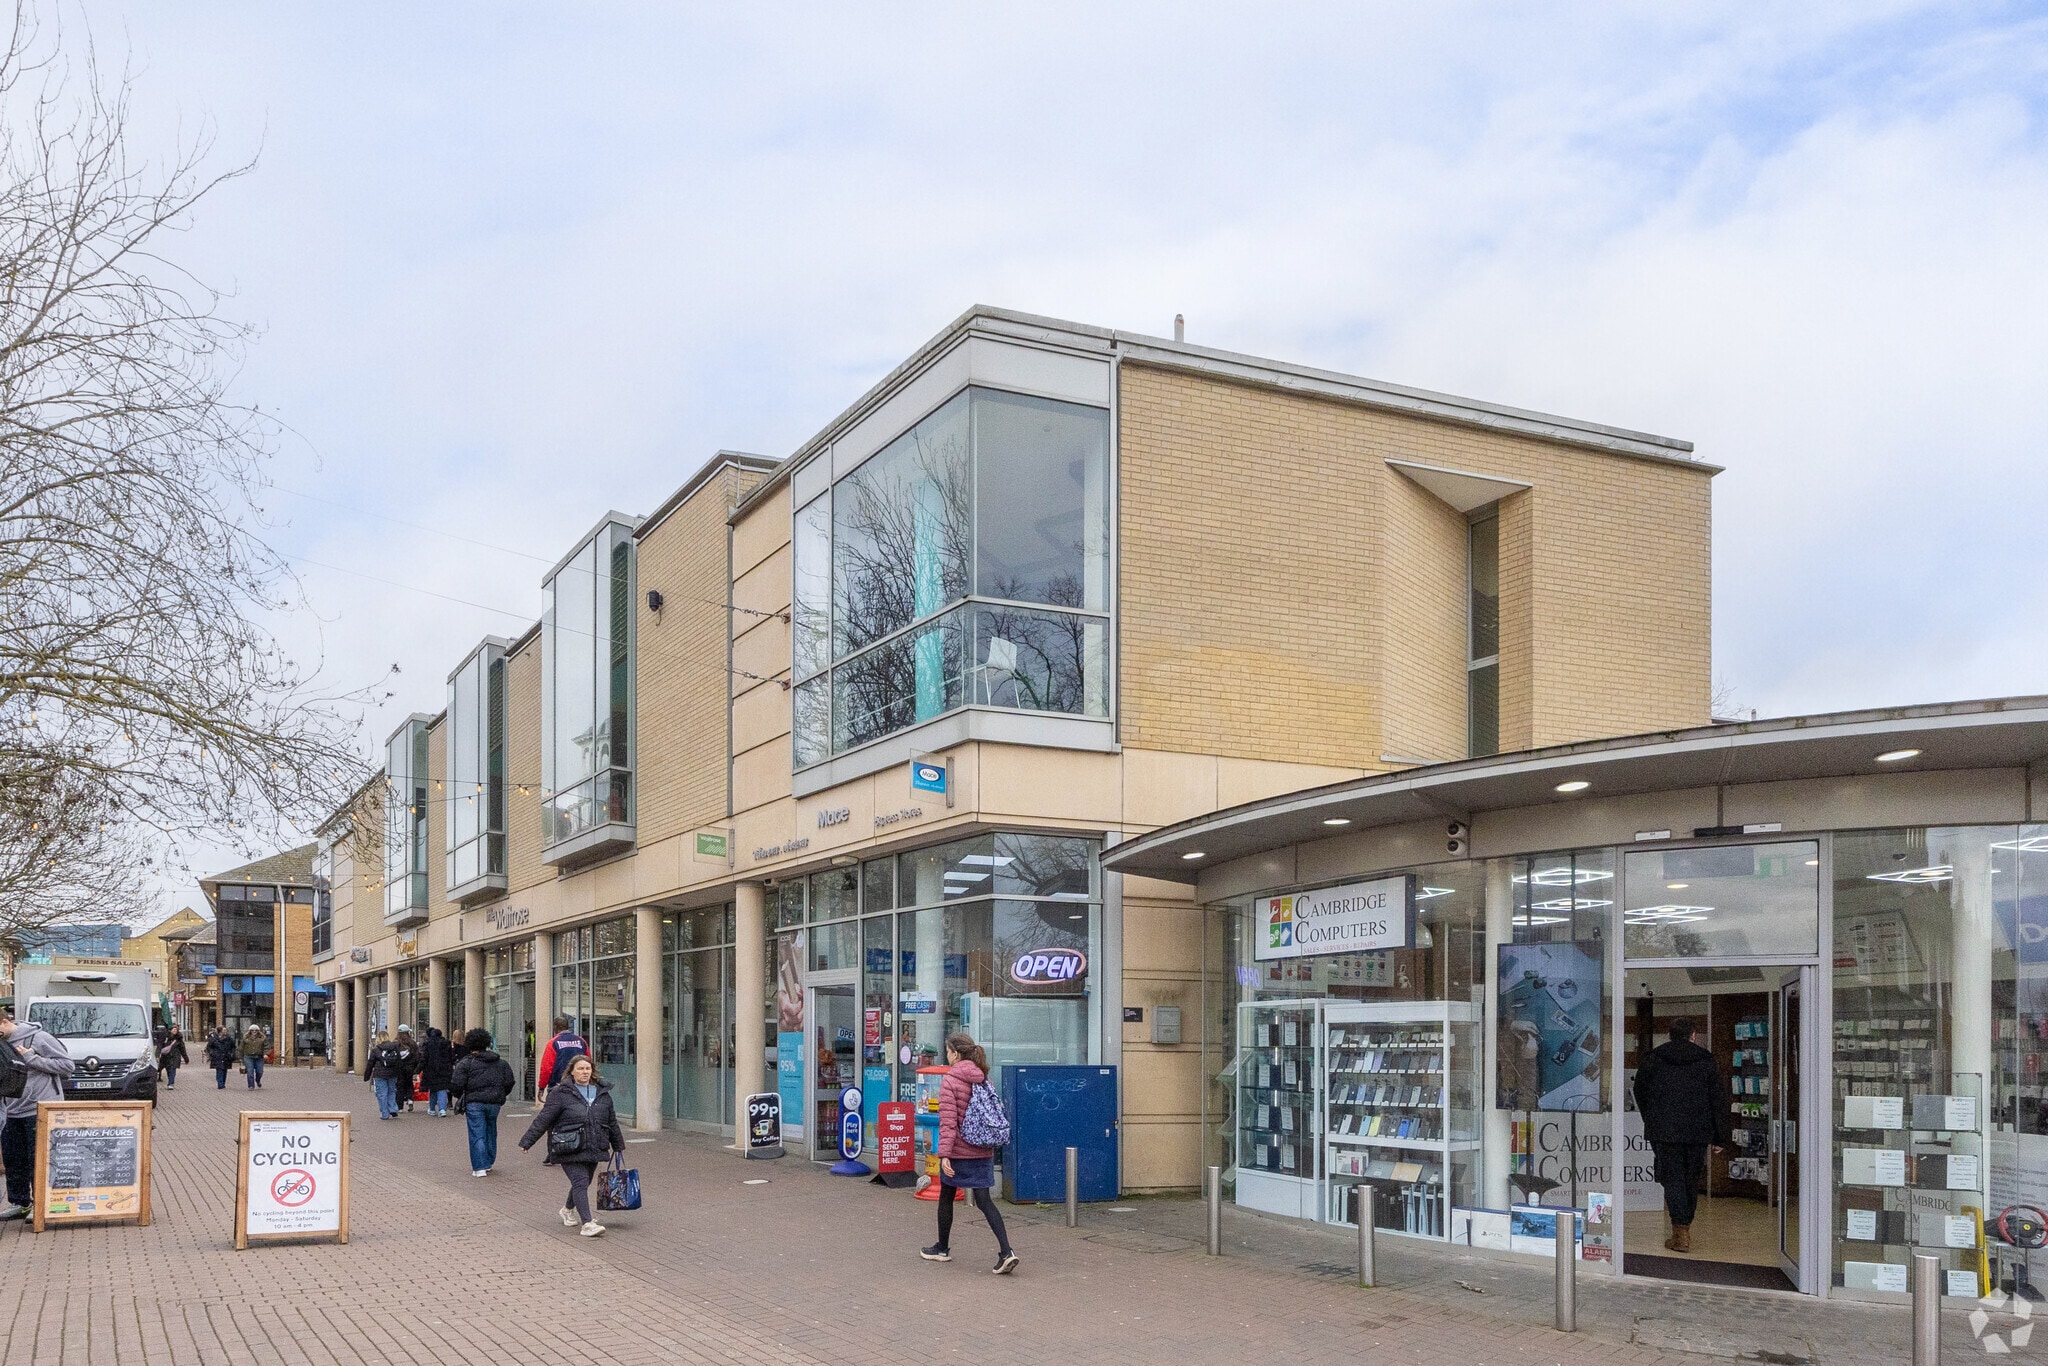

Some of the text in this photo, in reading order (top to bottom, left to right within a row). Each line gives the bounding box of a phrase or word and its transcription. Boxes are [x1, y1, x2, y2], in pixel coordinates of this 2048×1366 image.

[818, 806, 850, 829] Mace
[495, 905, 529, 930] Waitrose
[1016, 955, 1079, 978] OPEN
[905, 1002, 917, 1010] FREE
[780, 1060, 796, 1072] 95%
[749, 1103, 779, 1118] 99p
[54, 1128, 134, 1137] OPENING HOURS
[281, 1135, 311, 1149] NO
[252, 1151, 337, 1166] CYCLING
[1585, 1247, 1612, 1256] ALARM
